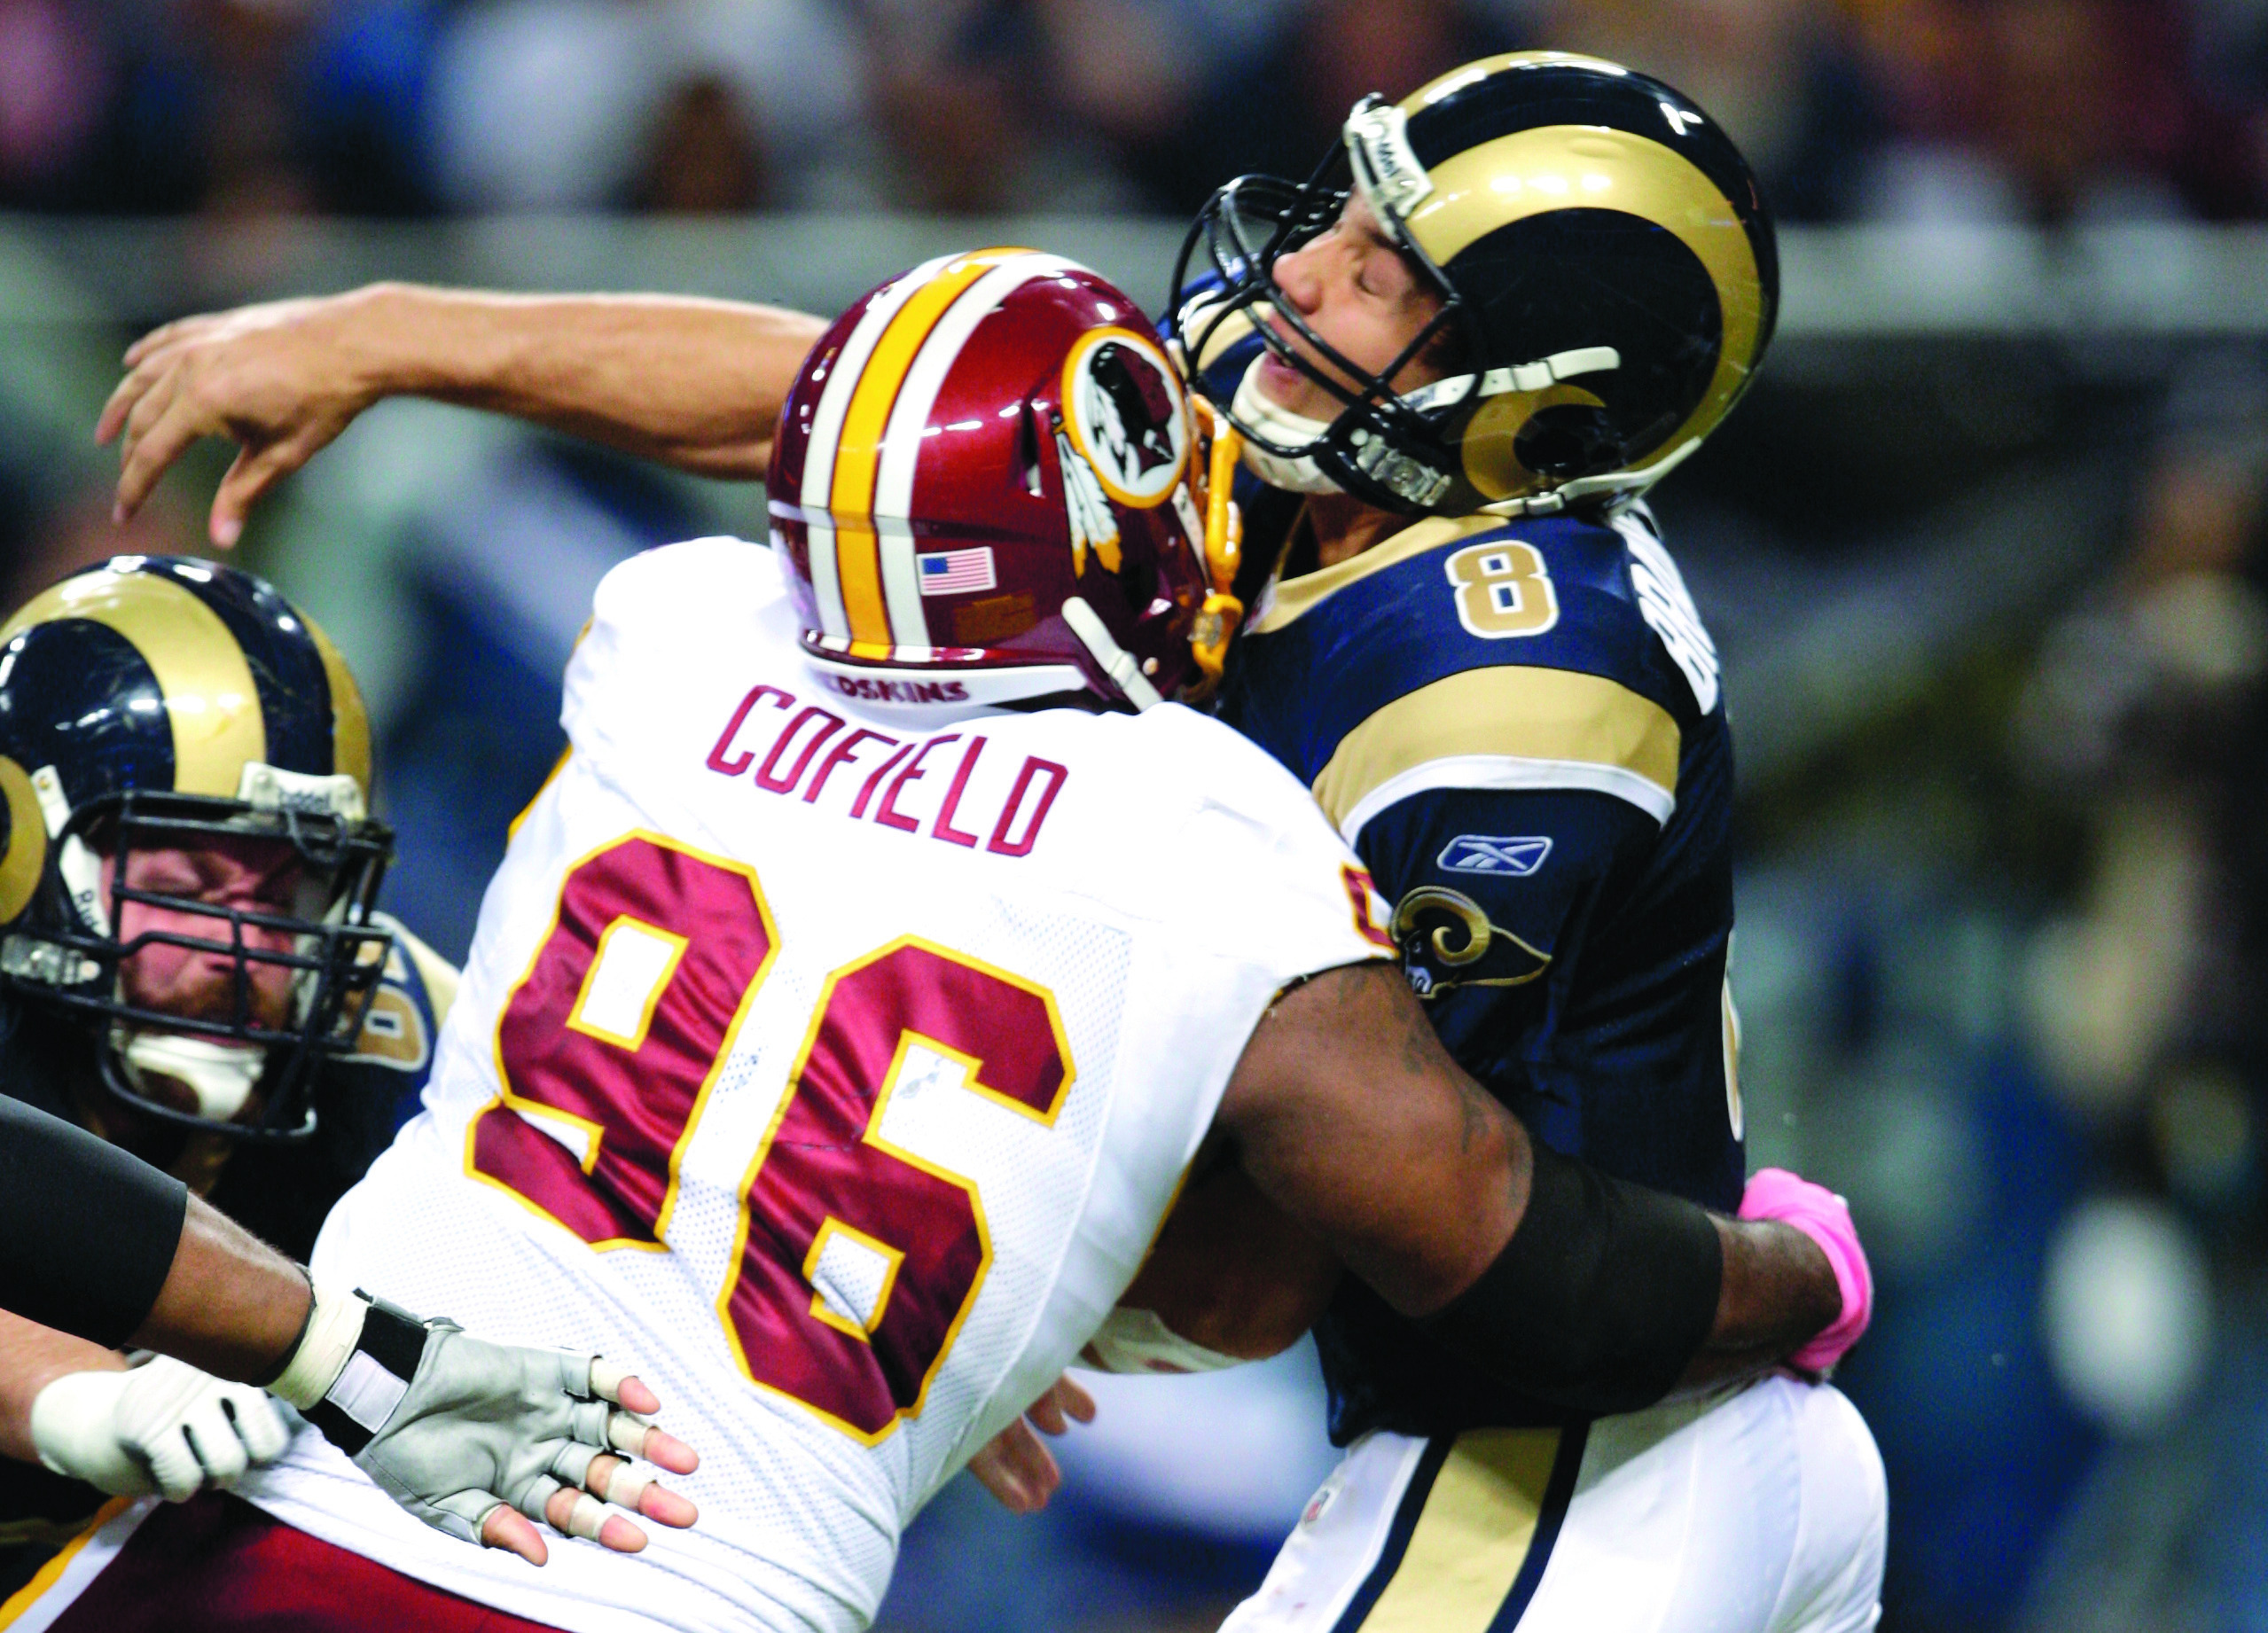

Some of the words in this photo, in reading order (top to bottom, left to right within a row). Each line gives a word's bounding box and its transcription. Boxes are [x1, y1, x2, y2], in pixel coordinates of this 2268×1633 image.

[1444, 539, 1560, 640] 8
[706, 684, 1068, 857] COFIELD
[464, 828, 1077, 1449] 96
